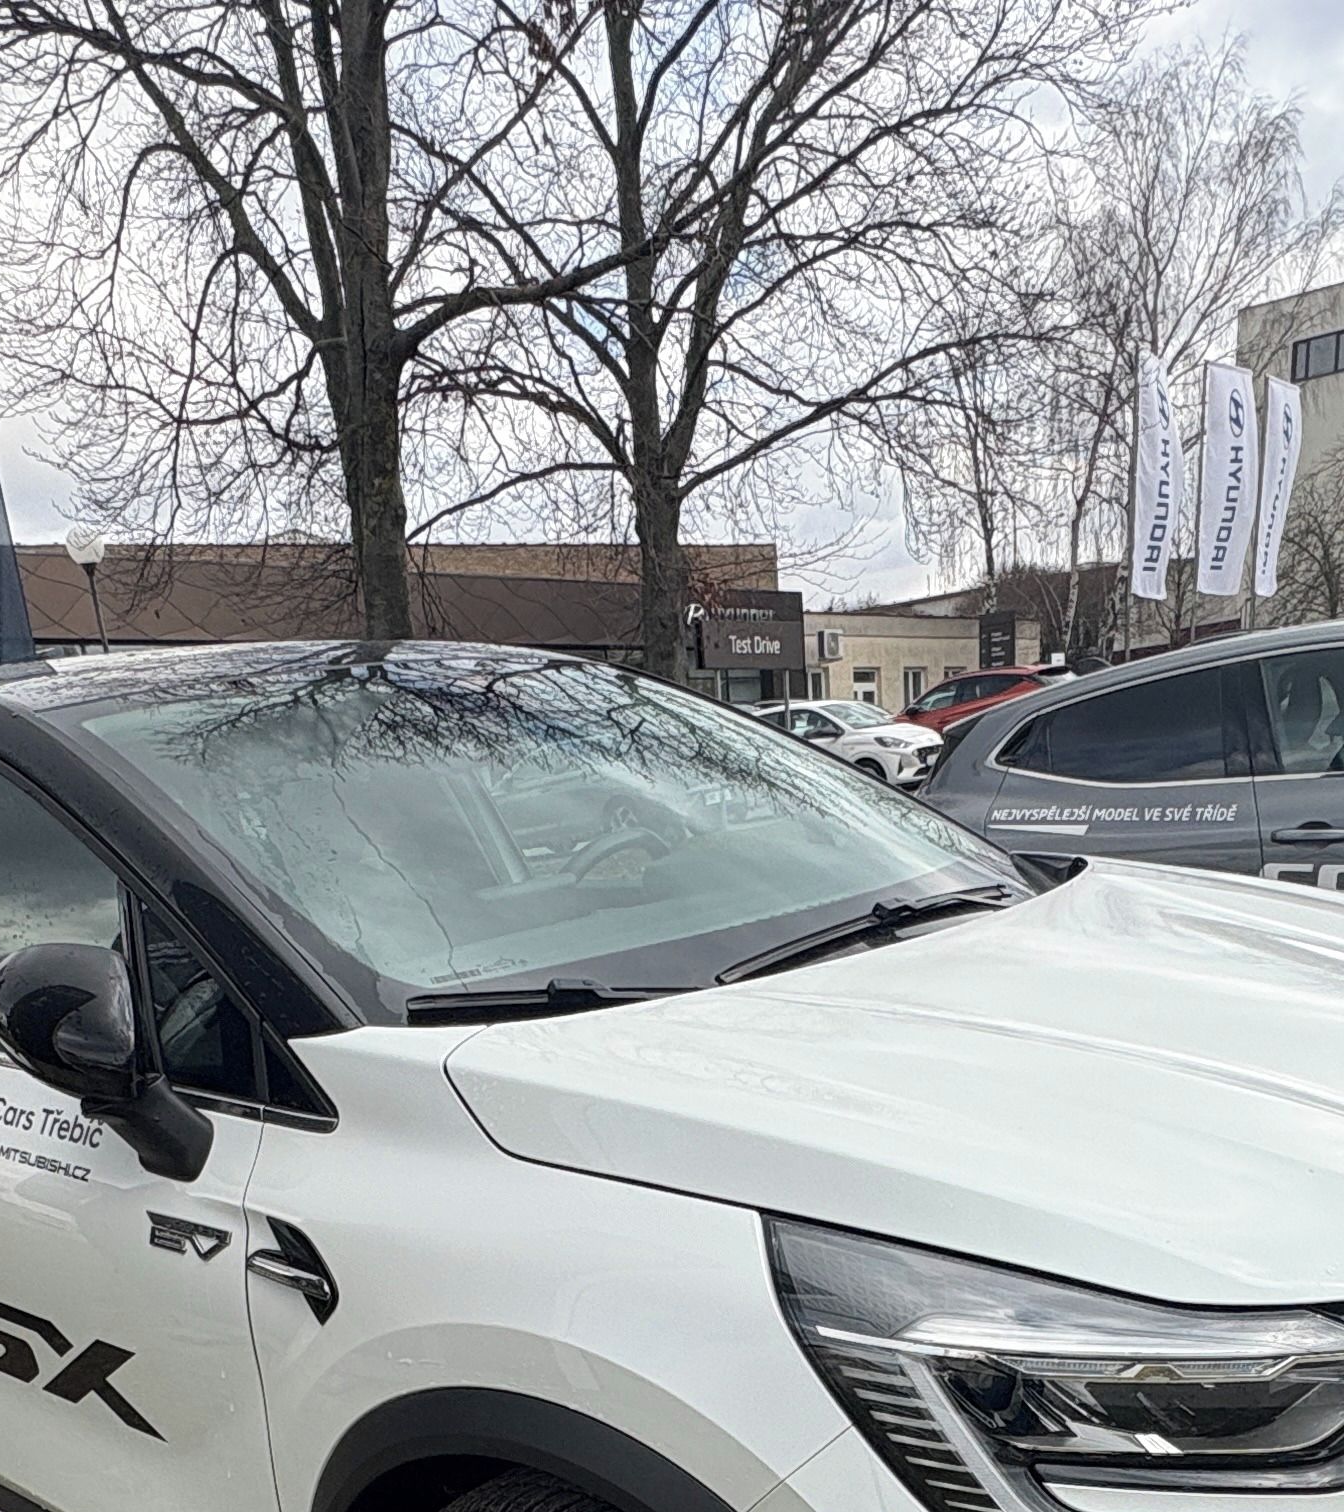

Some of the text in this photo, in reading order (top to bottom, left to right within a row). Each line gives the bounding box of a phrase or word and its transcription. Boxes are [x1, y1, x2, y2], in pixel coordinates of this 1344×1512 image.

[1142, 438, 1170, 573] HYUNDAI
[1209, 445, 1244, 571] HYUNDAI
[728, 634, 781, 655] Test Drive
[991, 803, 1239, 822] NEJVYSPĚLEJŠÍ MODEL VE SVÉ TŘÍDĚ
